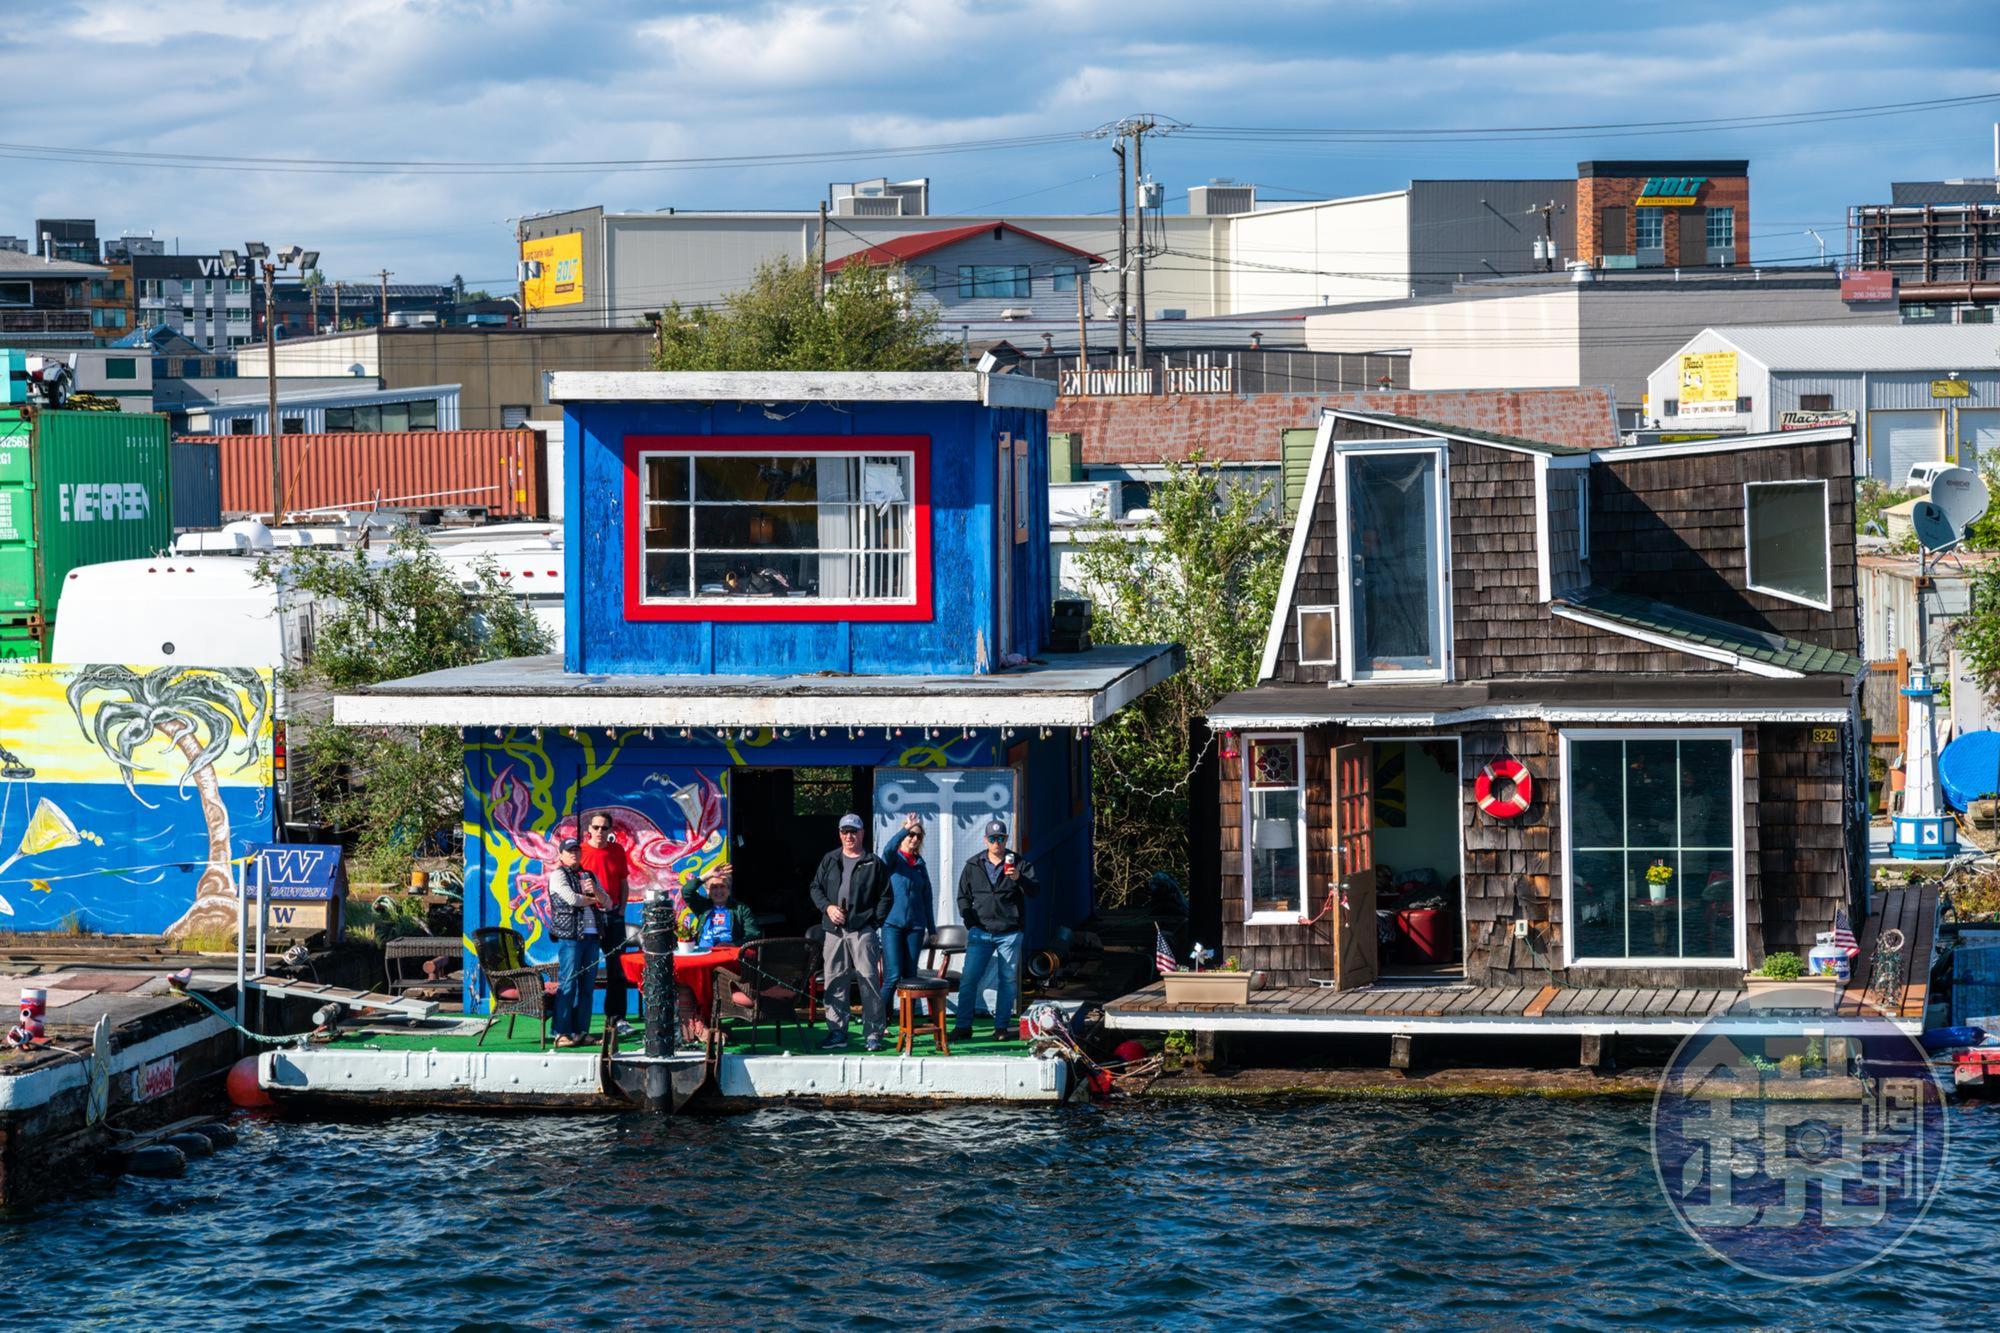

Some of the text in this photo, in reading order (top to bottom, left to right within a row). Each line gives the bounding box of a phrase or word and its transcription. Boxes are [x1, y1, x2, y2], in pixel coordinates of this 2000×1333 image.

[1641, 177, 1707, 196] BOLT
[1783, 412, 1820, 424] Mac's
[59, 483, 150, 522] EVERGREEN
[1814, 731, 1836, 741] 824
[273, 907, 296, 924] W
